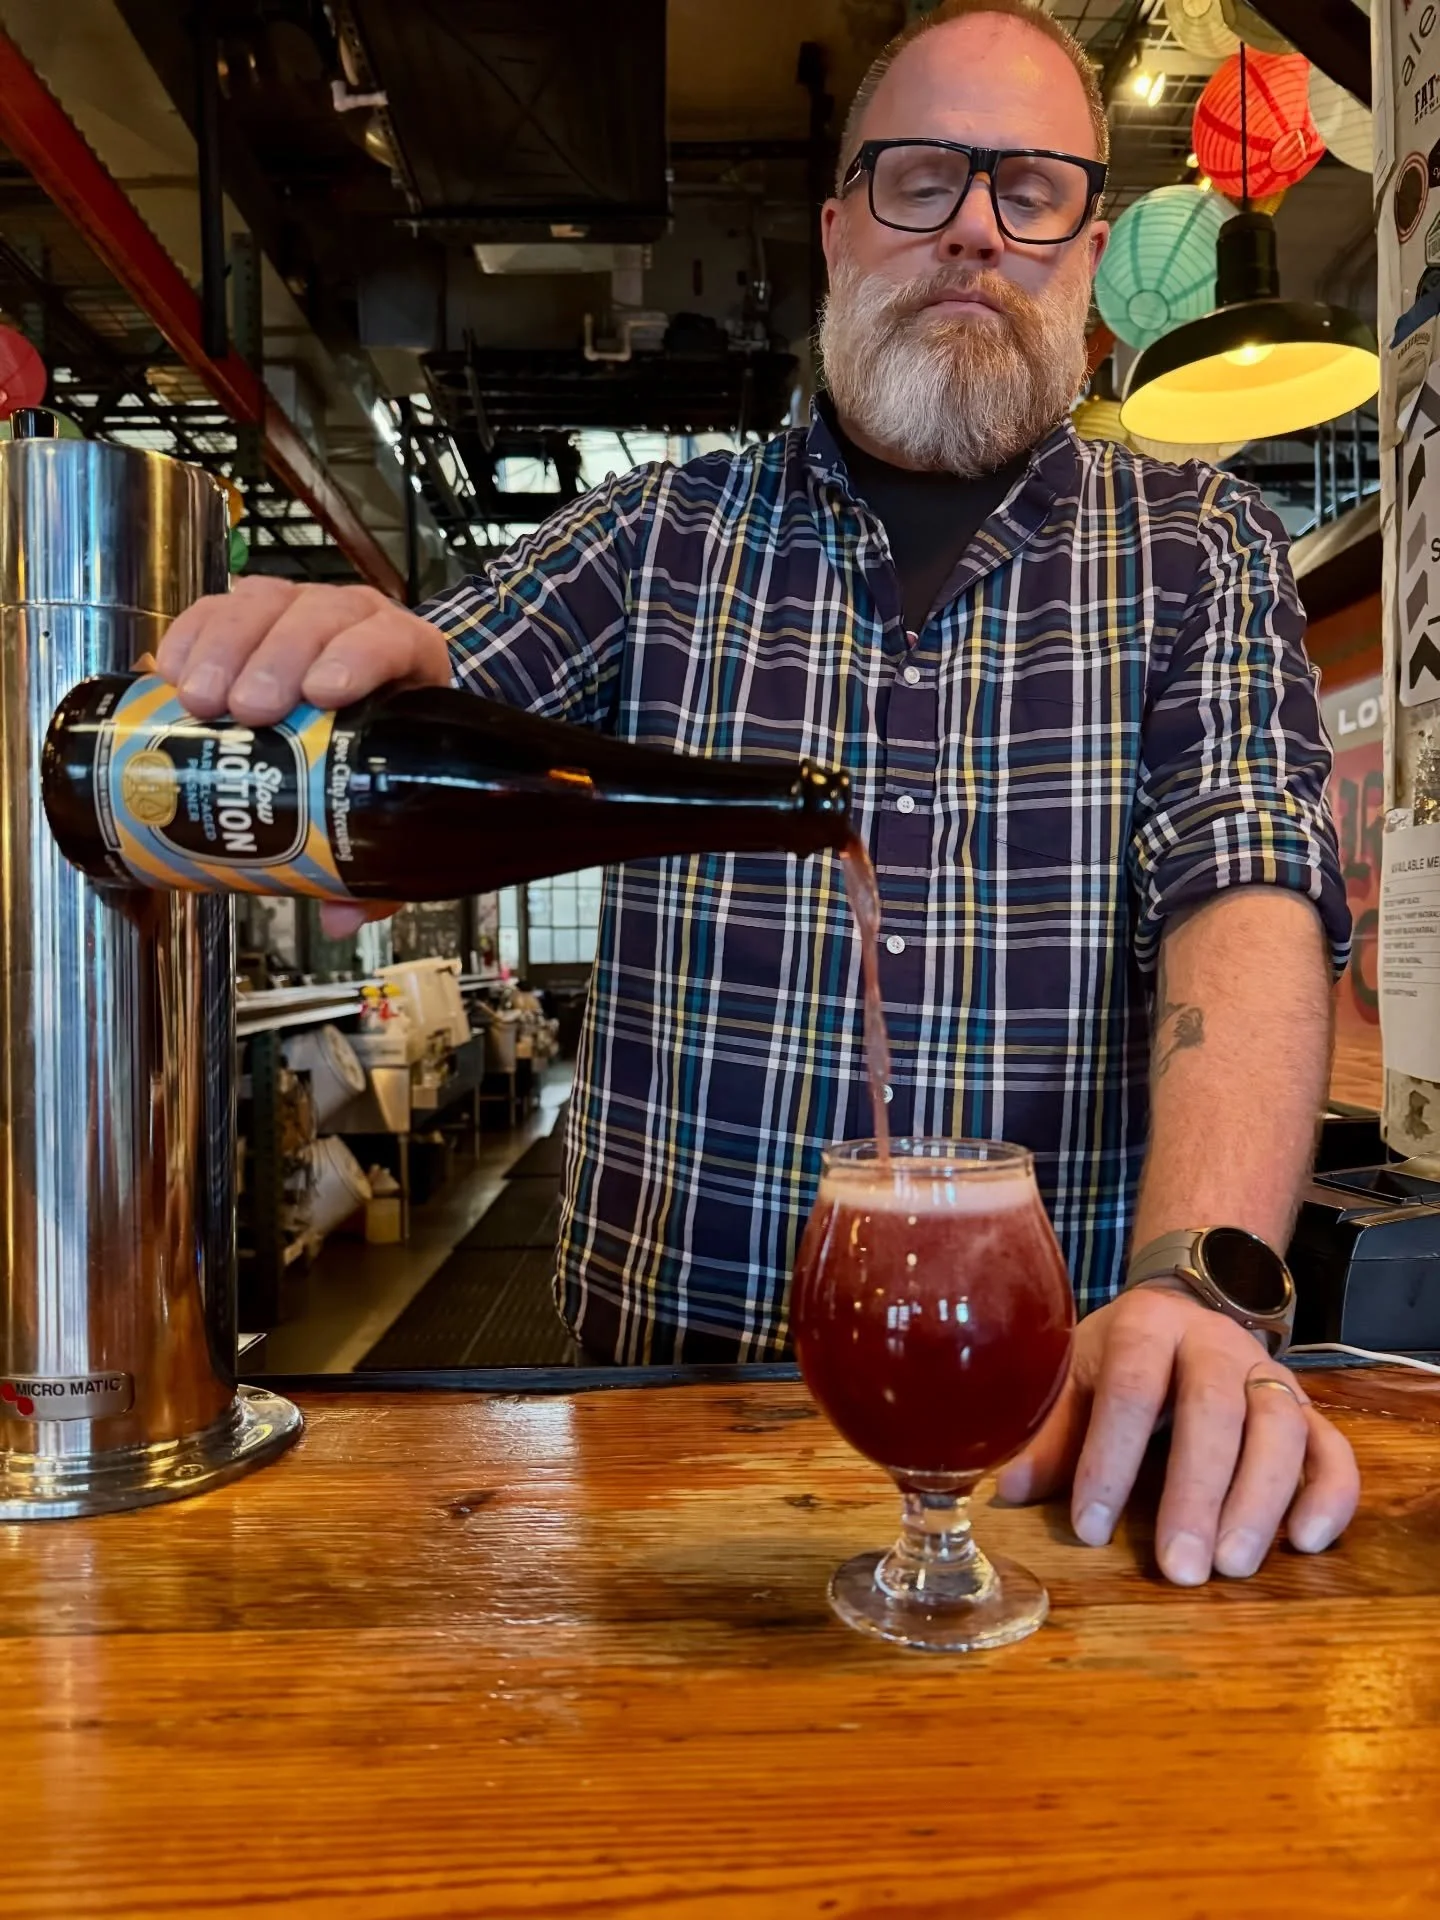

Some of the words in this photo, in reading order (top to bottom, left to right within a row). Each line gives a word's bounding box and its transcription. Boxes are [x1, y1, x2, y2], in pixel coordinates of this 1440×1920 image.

[1414, 73, 1436, 117] FAT
[332, 730, 356, 763] Love
[216, 729, 257, 852] MOTION
[253, 762, 283, 825] Slow
[327, 764, 352, 798] City
[332, 797, 355, 862] Brewing
[15, 1383, 65, 1396] MICRO
[70, 1378, 121, 1396] MATIC
